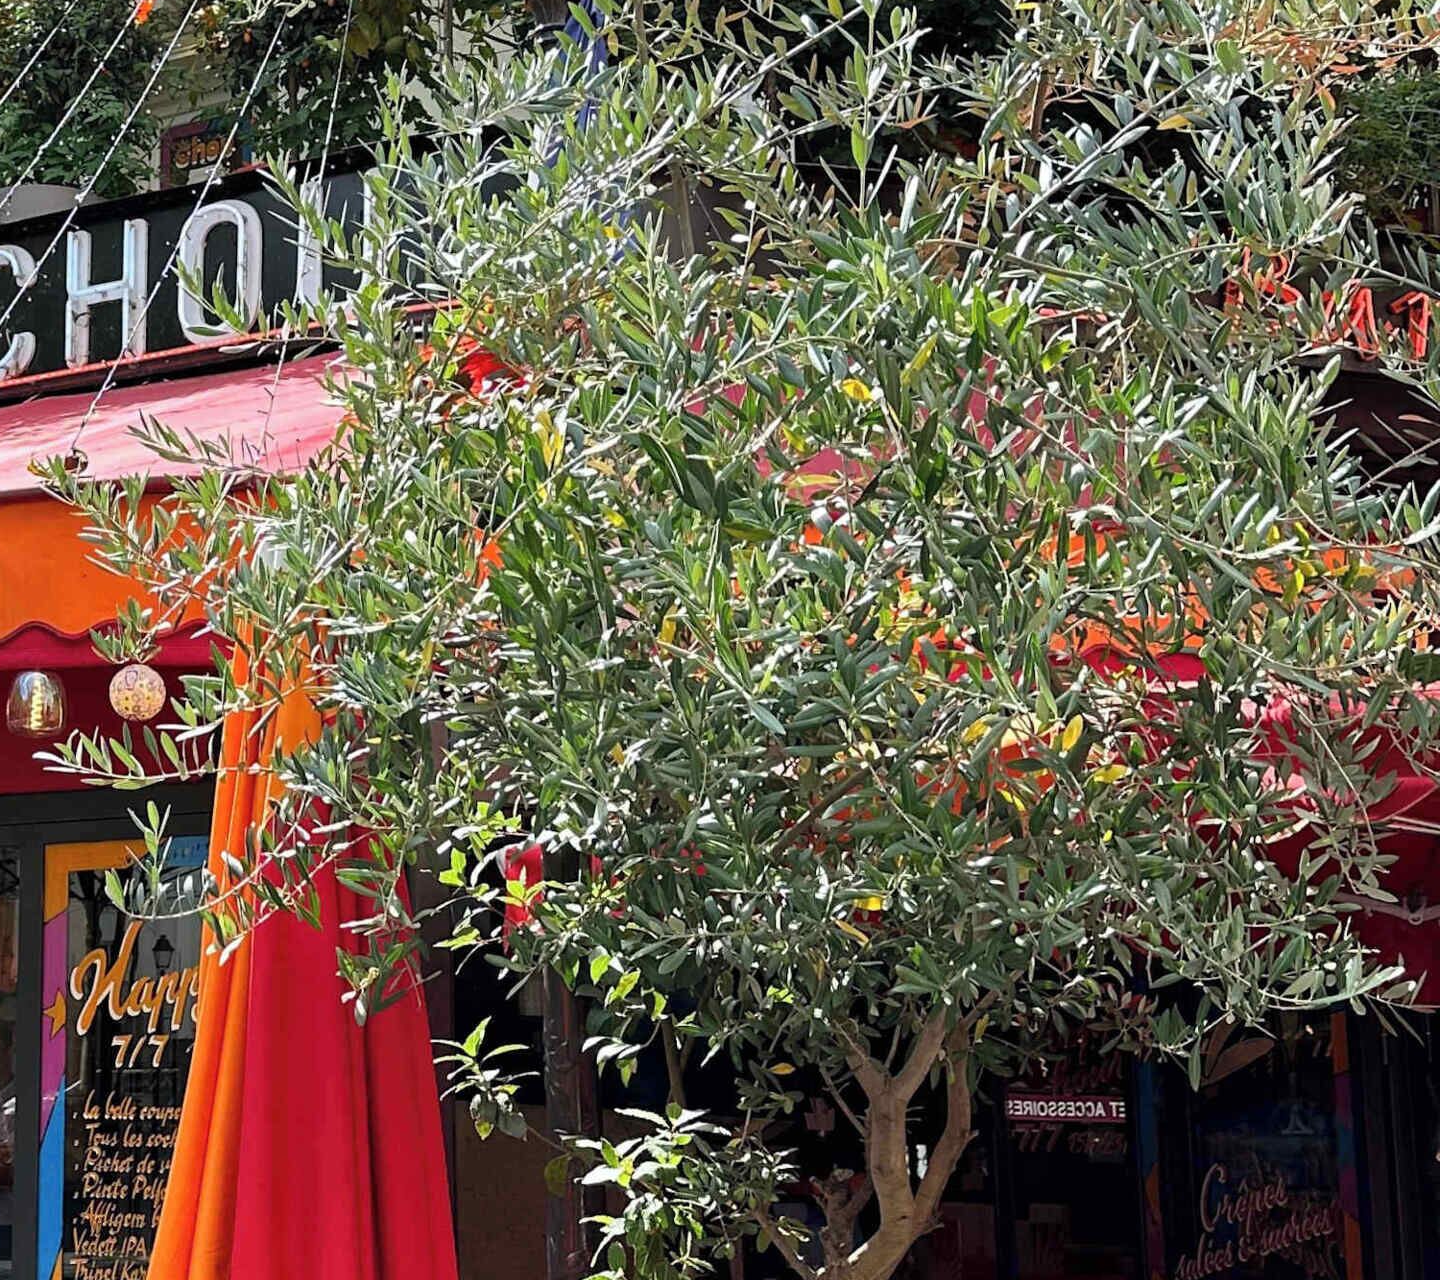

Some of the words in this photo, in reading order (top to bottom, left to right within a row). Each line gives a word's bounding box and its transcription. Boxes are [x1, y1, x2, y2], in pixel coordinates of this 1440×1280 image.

[70, 920, 200, 1036] Happ
[111, 1033, 170, 1068] 7/7
[105, 1090, 137, 1120] belle
[85, 1122, 118, 1147] Tous
[123, 1123, 143, 1148] les
[82, 1146, 134, 1173] Pichet
[136, 1153, 155, 1174] de
[81, 1172, 129, 1200] Pinte
[80, 1200, 146, 1237] Affligem
[73, 1227, 117, 1257] Vedett
[120, 1235, 148, 1260] IPA
